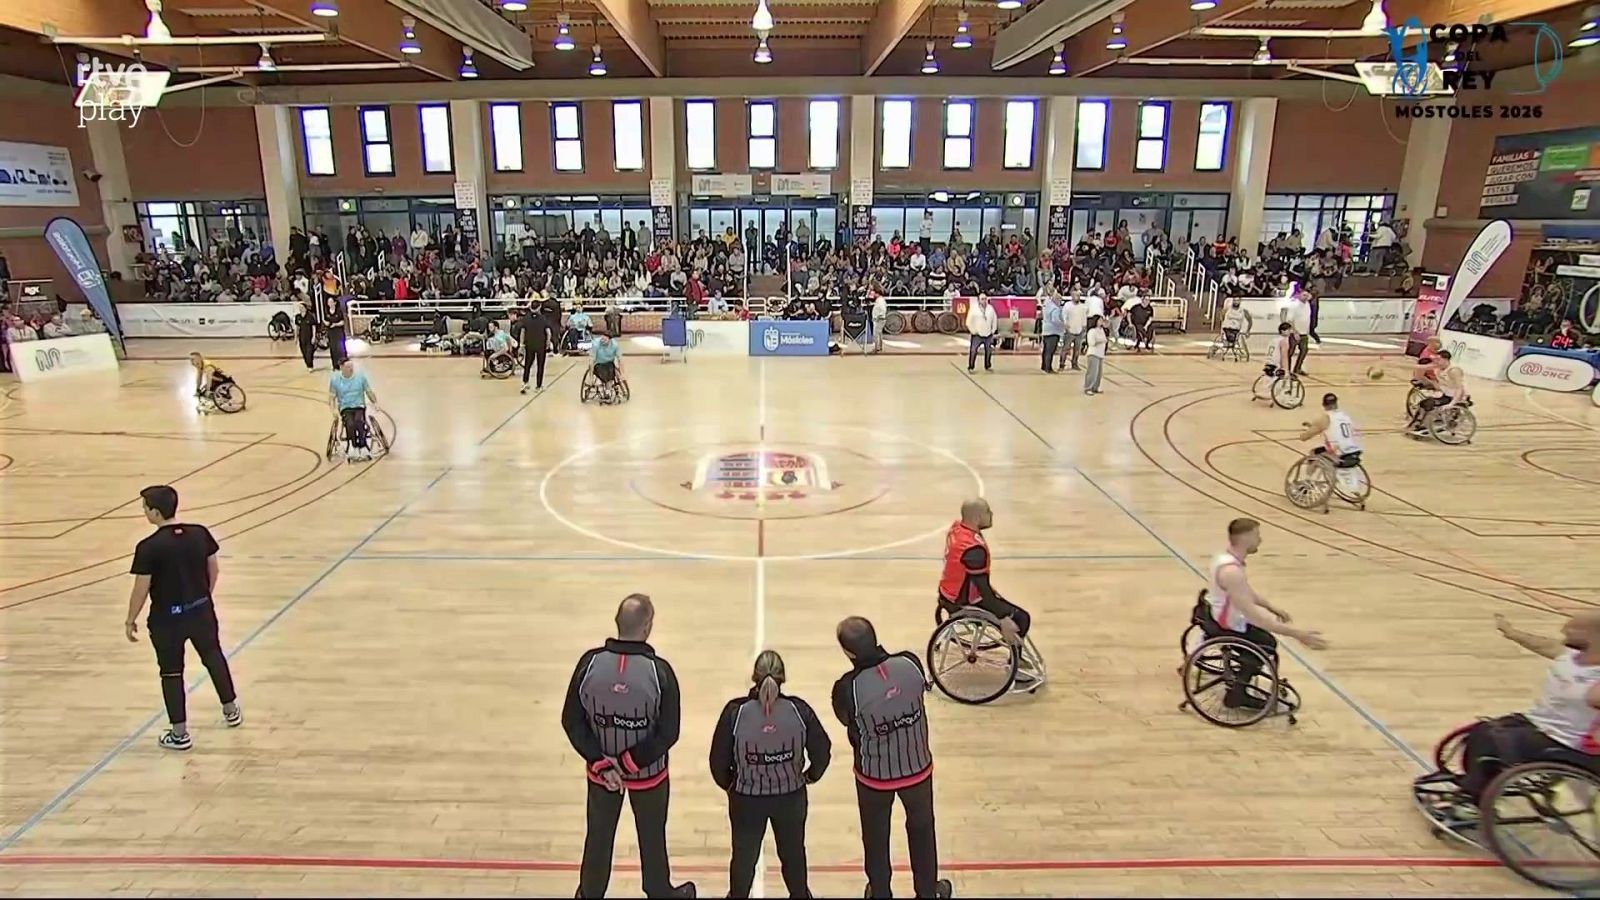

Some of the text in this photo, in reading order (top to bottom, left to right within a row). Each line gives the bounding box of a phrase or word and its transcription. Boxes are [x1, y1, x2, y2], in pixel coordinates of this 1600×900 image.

[1491, 151, 1530, 164] FAMILIAS
[1490, 161, 1534, 173] QUEREMOS
[1515, 172, 1534, 181] CON
[1486, 186, 1512, 195] ESTAS
[1552, 335, 1569, 349] 24
[1542, 370, 1572, 380] ONCE
